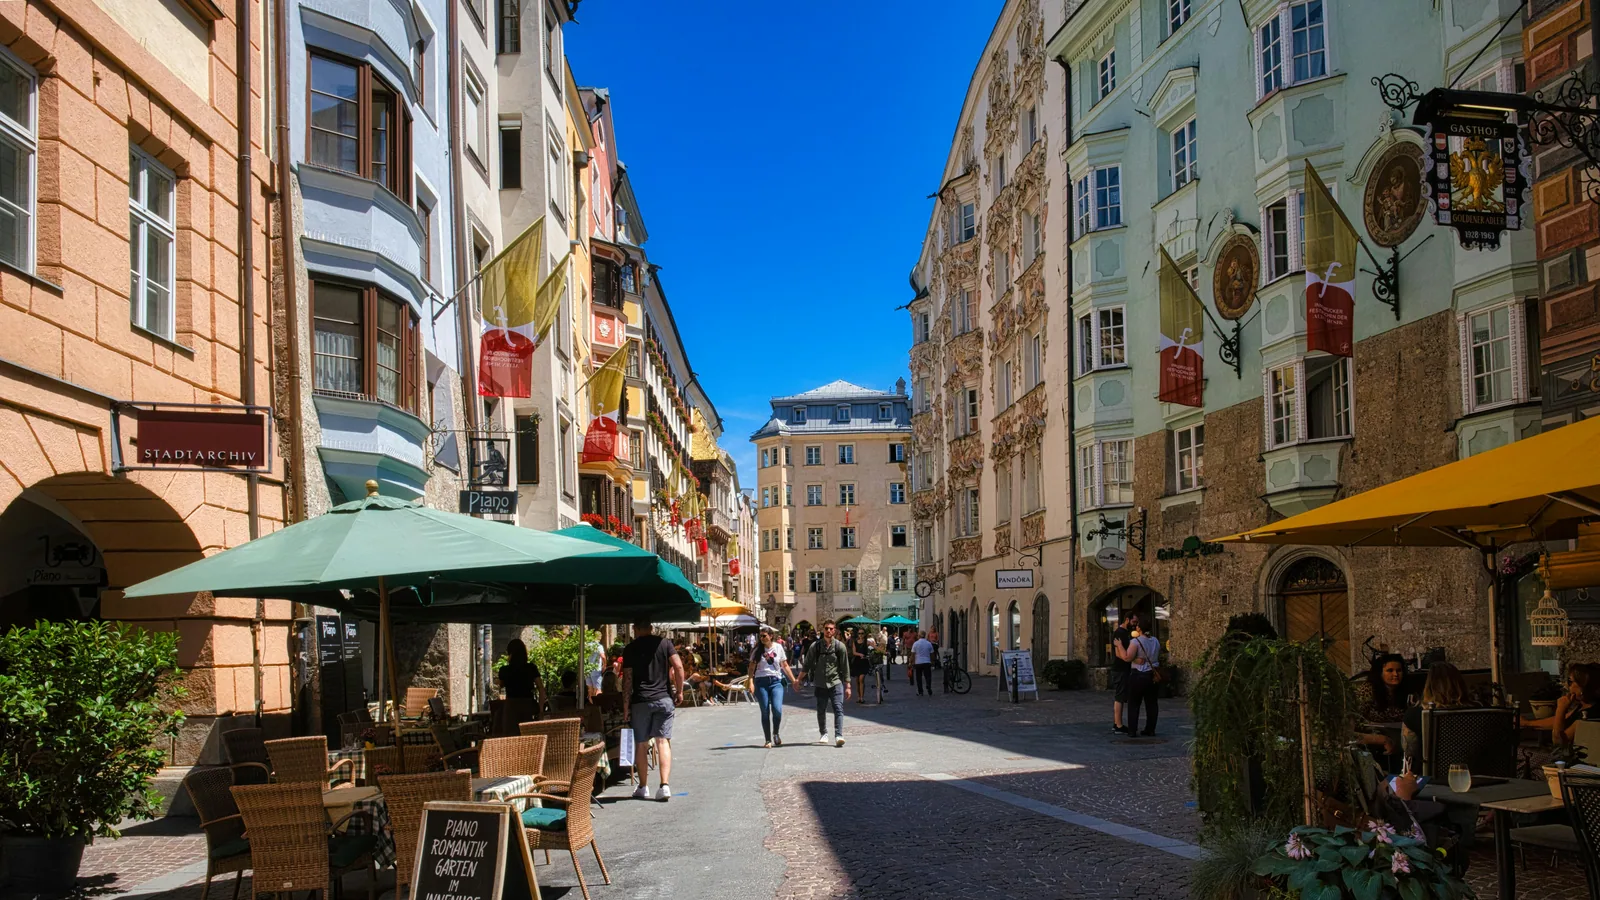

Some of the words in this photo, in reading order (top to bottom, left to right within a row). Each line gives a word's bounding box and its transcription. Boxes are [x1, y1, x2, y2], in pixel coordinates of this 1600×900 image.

[1450, 124, 1499, 136] GASTHOF
[1452, 213, 1485, 224] GOLDENER
[1486, 215, 1504, 225] ADLER
[144, 449, 256, 460] STADTARCHIV
[469, 491, 509, 513] Piano
[33, 569, 61, 582] Piano
[444, 819, 479, 838] PIANO
[430, 838, 488, 858] ROMANTIK
[435, 858, 479, 878] GARTEN
[448, 879, 460, 892] IM
